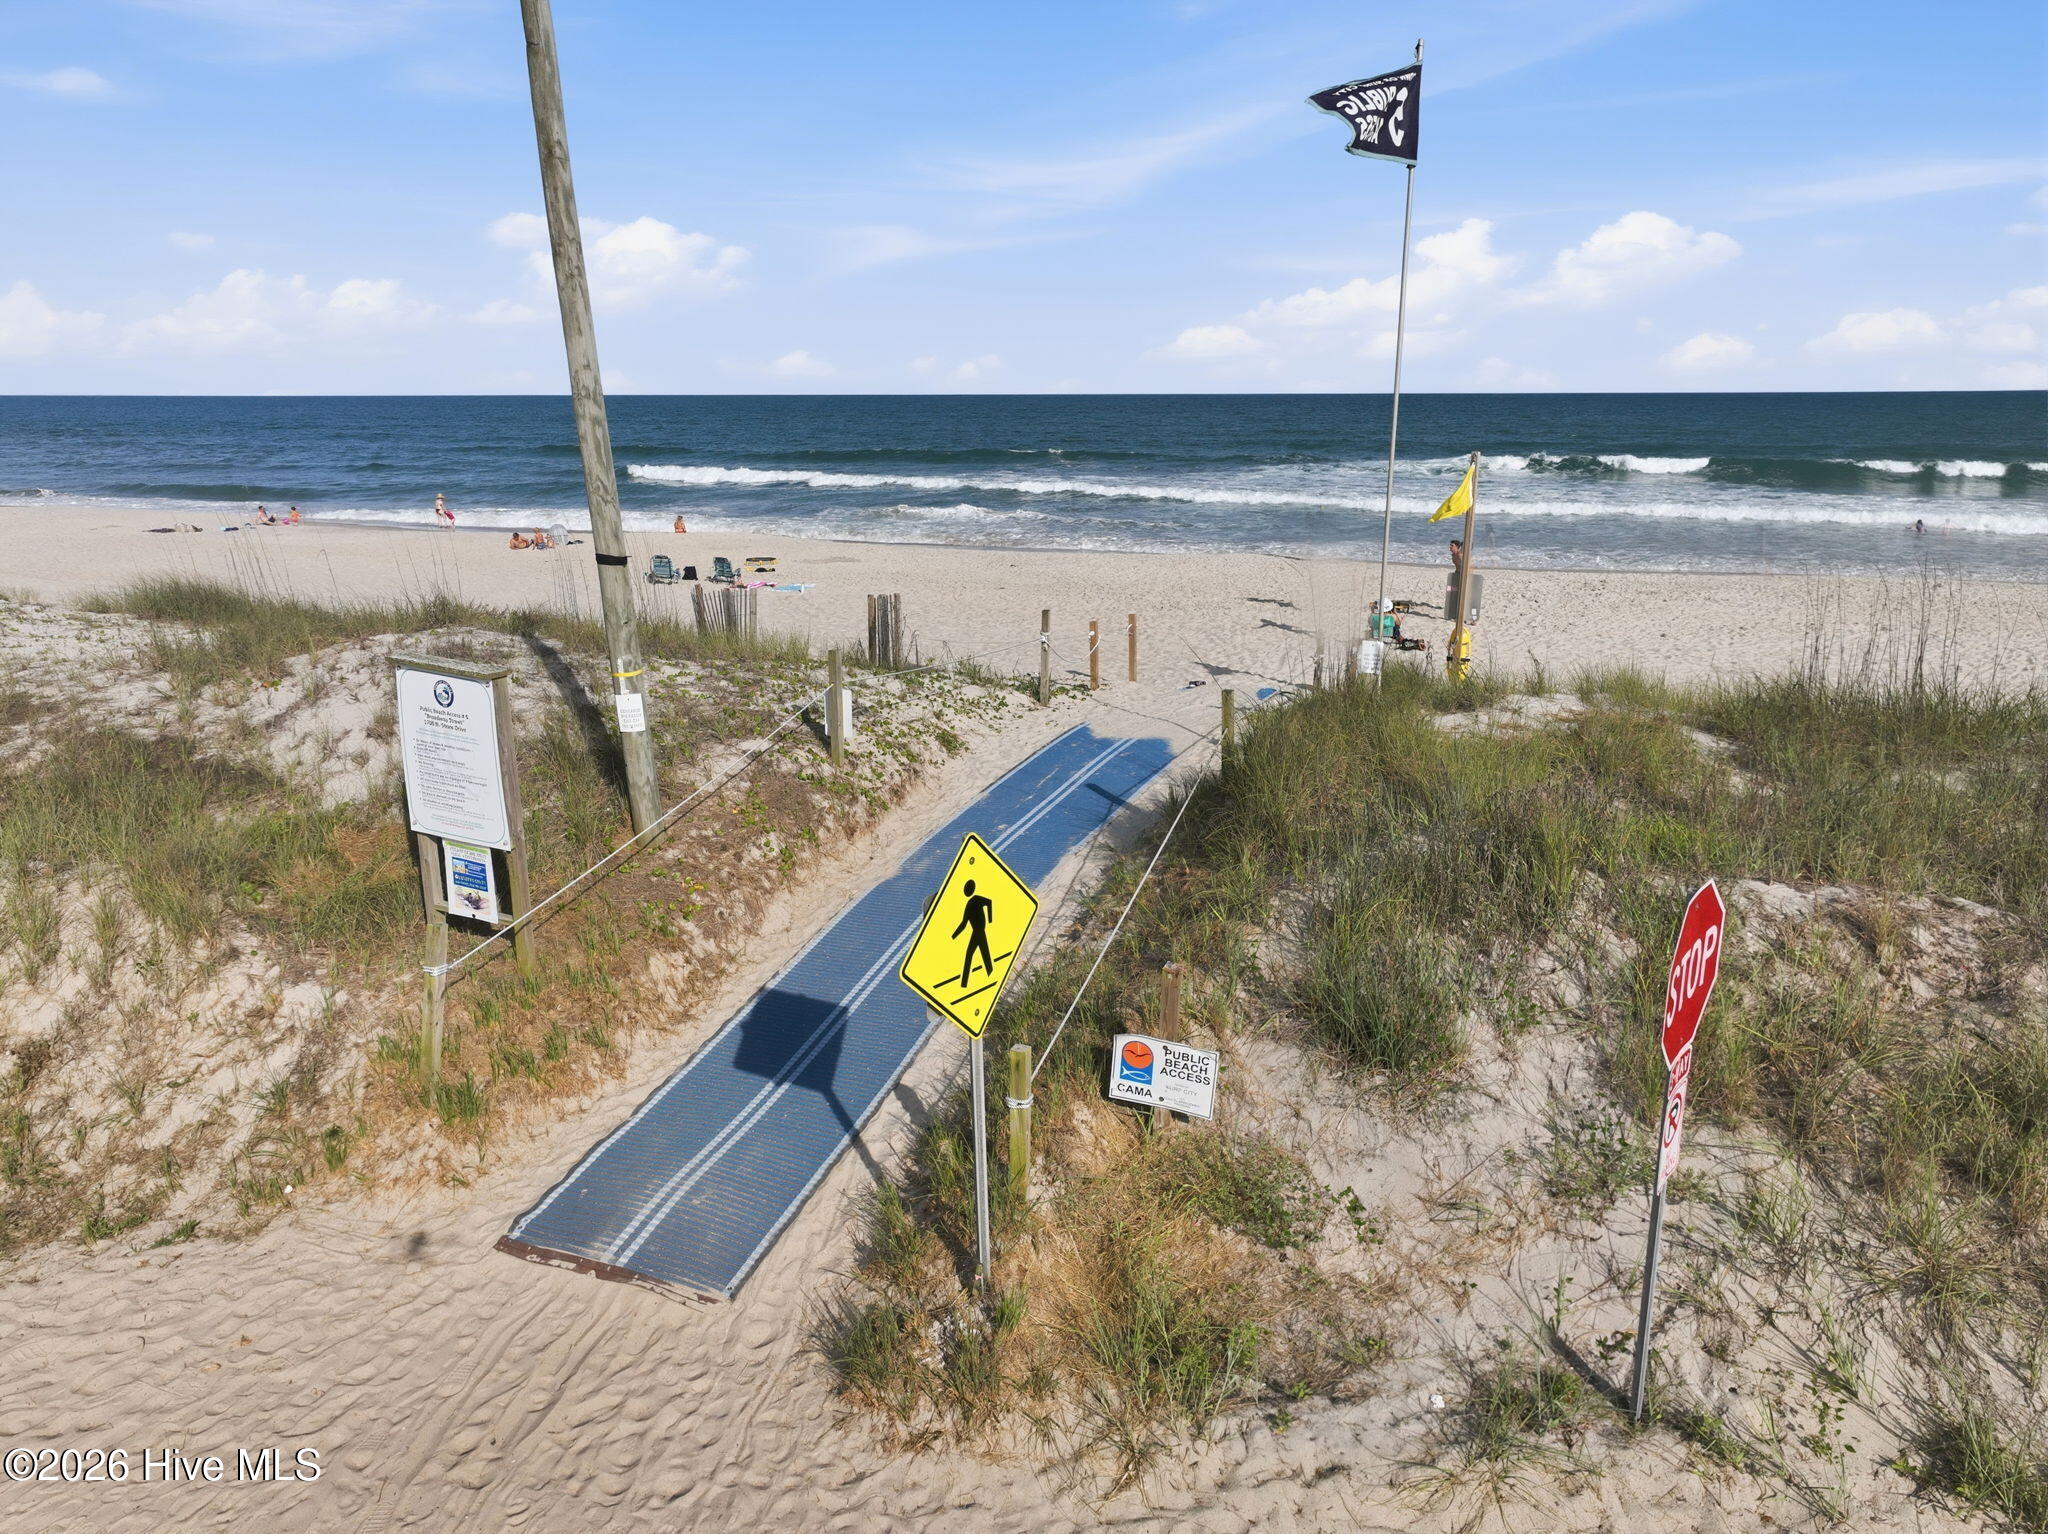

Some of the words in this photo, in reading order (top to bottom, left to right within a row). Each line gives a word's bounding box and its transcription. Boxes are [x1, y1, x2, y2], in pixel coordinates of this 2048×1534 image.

[1667, 925, 1718, 1028] STOP
[1164, 1048, 1210, 1066] PUBLIC
[1160, 1067, 1211, 1085] ACCESS
[1165, 1058, 1208, 1076] BEACH
[1117, 1083, 1153, 1098] CAMA
